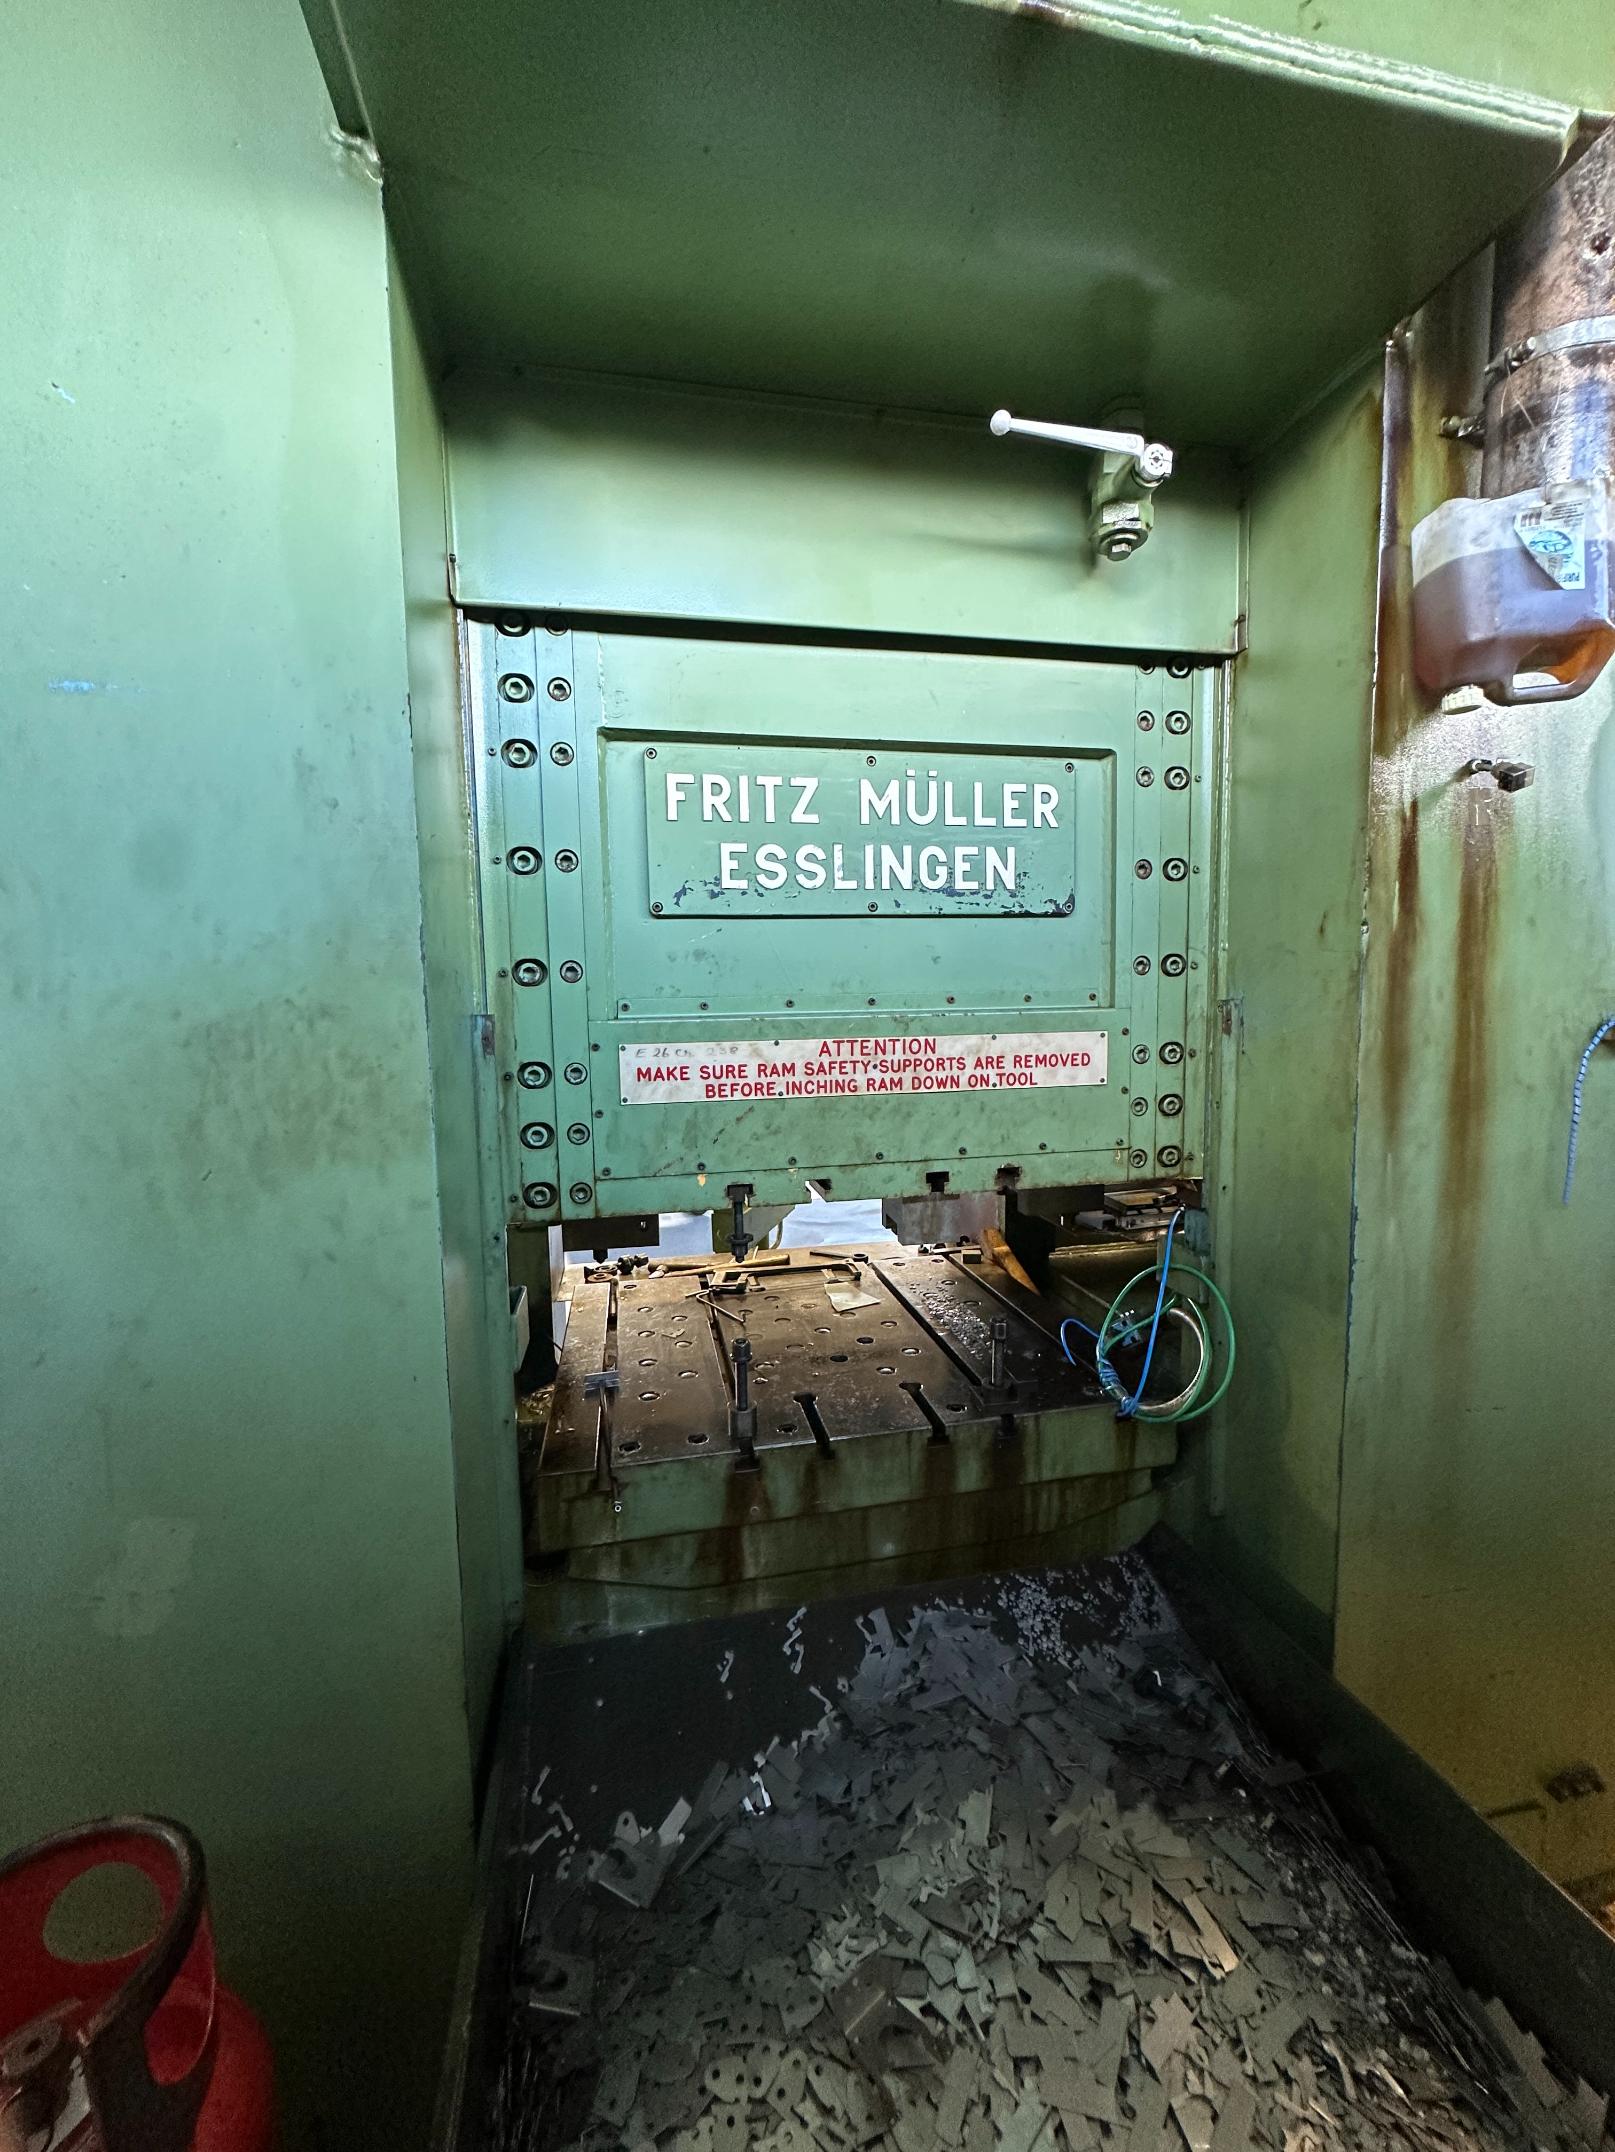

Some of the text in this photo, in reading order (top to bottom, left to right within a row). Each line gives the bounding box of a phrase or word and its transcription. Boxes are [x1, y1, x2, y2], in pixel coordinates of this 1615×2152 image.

[667, 770, 1058, 827] FRITZ MÜLLER
[721, 843, 1015, 889] ESSLINGEN
[818, 1038, 937, 1058] ATTENTION
[636, 1052, 1091, 1082] MAKE SURE RAM SAFETY SUPPORTS ARE REMOVED
[705, 1072, 1038, 1099] BEFORE INCHING RAM DOWN ON TOOL
